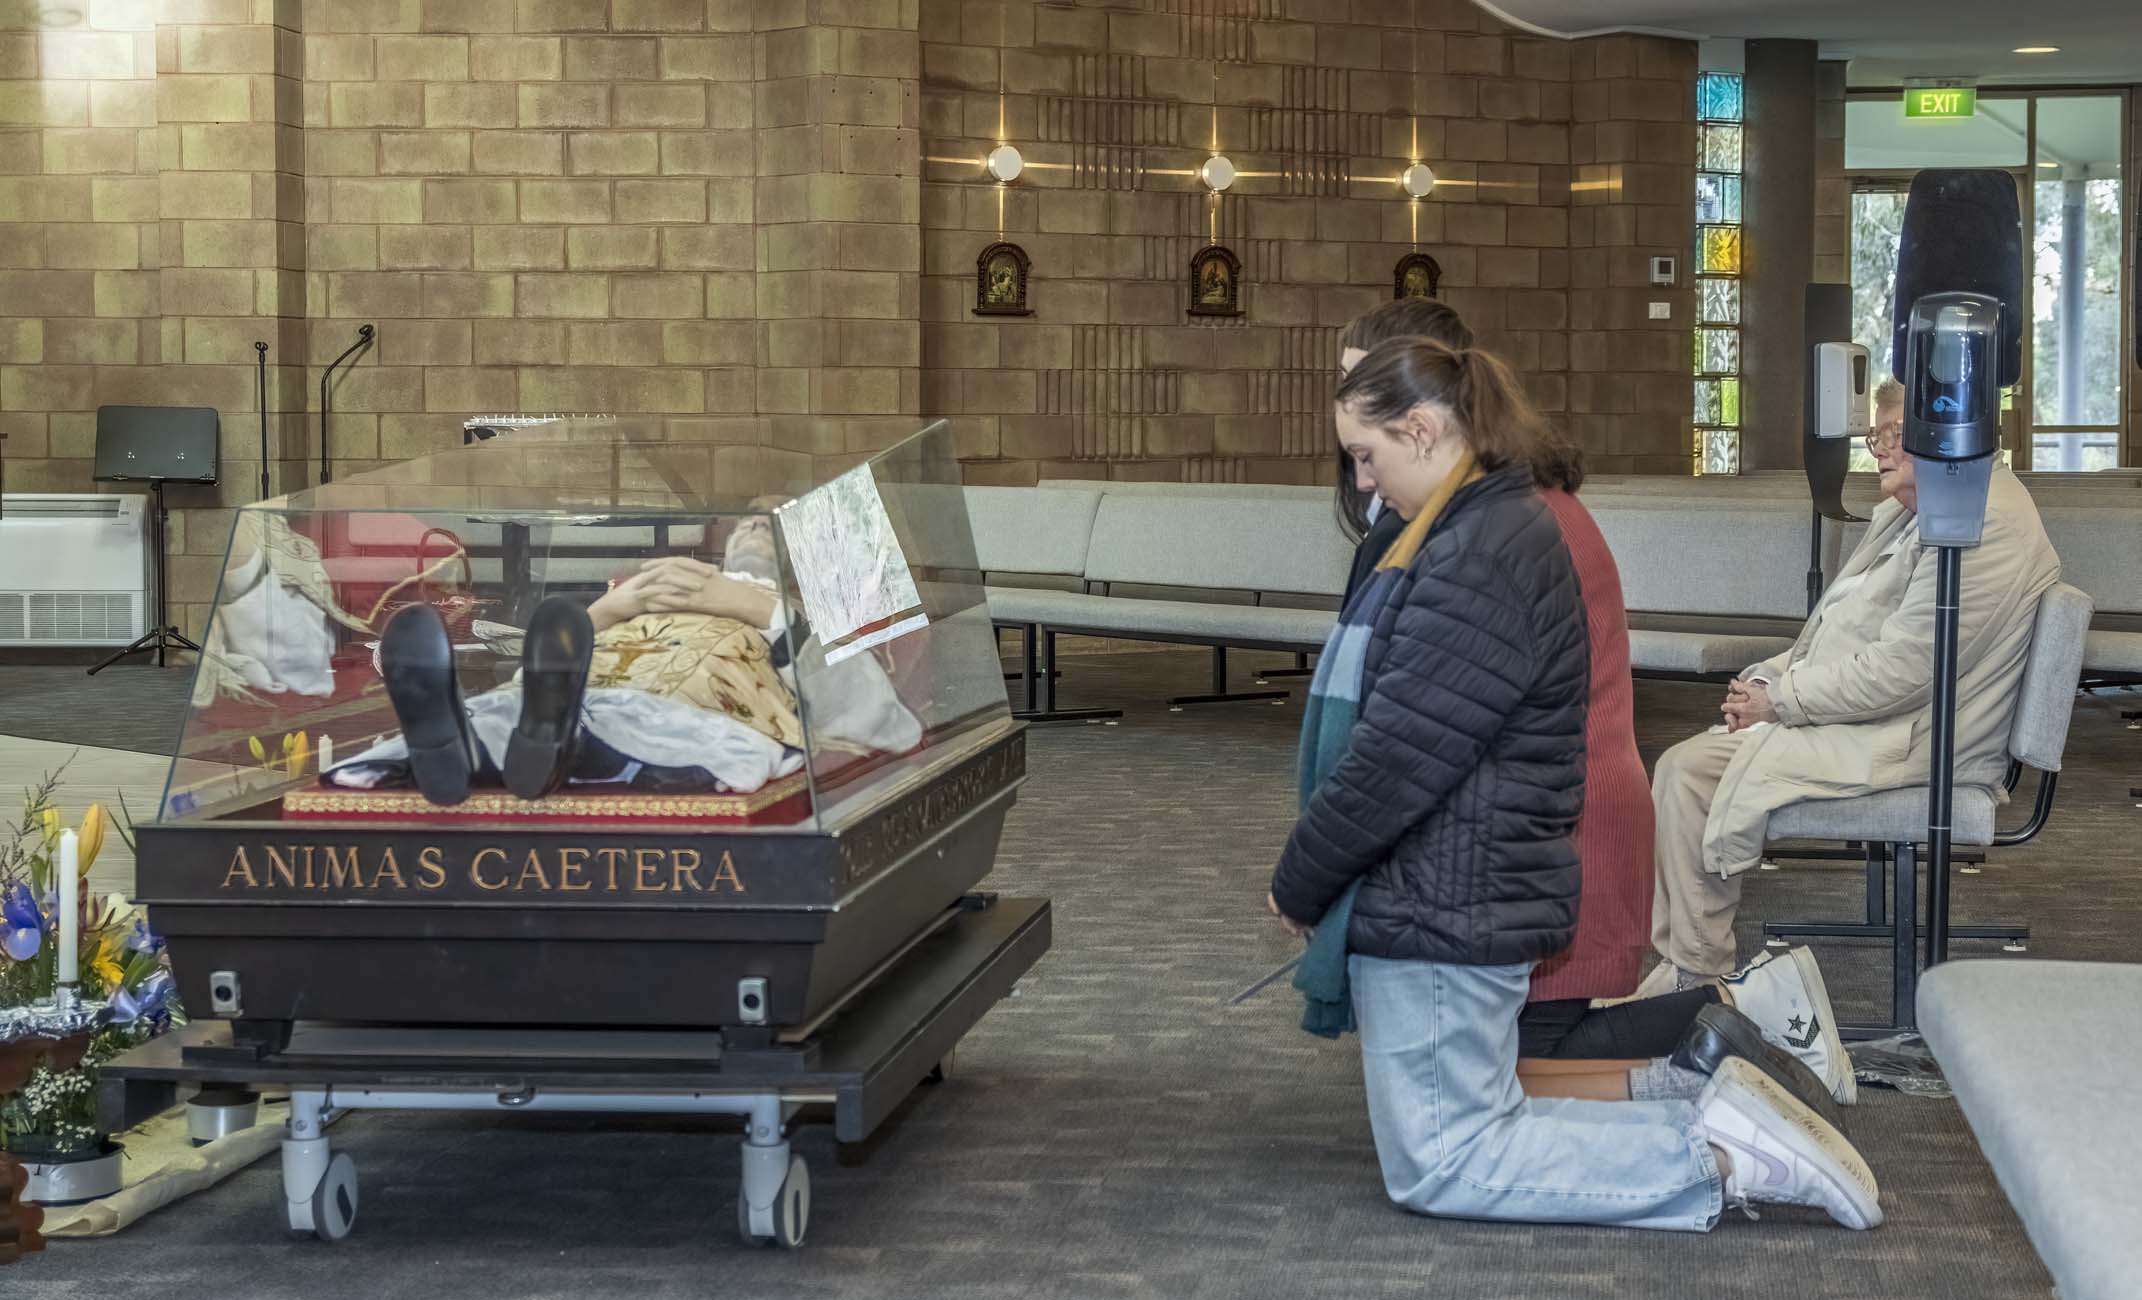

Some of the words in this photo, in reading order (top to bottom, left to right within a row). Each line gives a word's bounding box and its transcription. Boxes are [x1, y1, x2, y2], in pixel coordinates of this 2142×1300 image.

[1920, 93, 1961, 113] EXIT
[221, 845, 447, 889] ANIMAS
[469, 847, 746, 892] CAETERA
